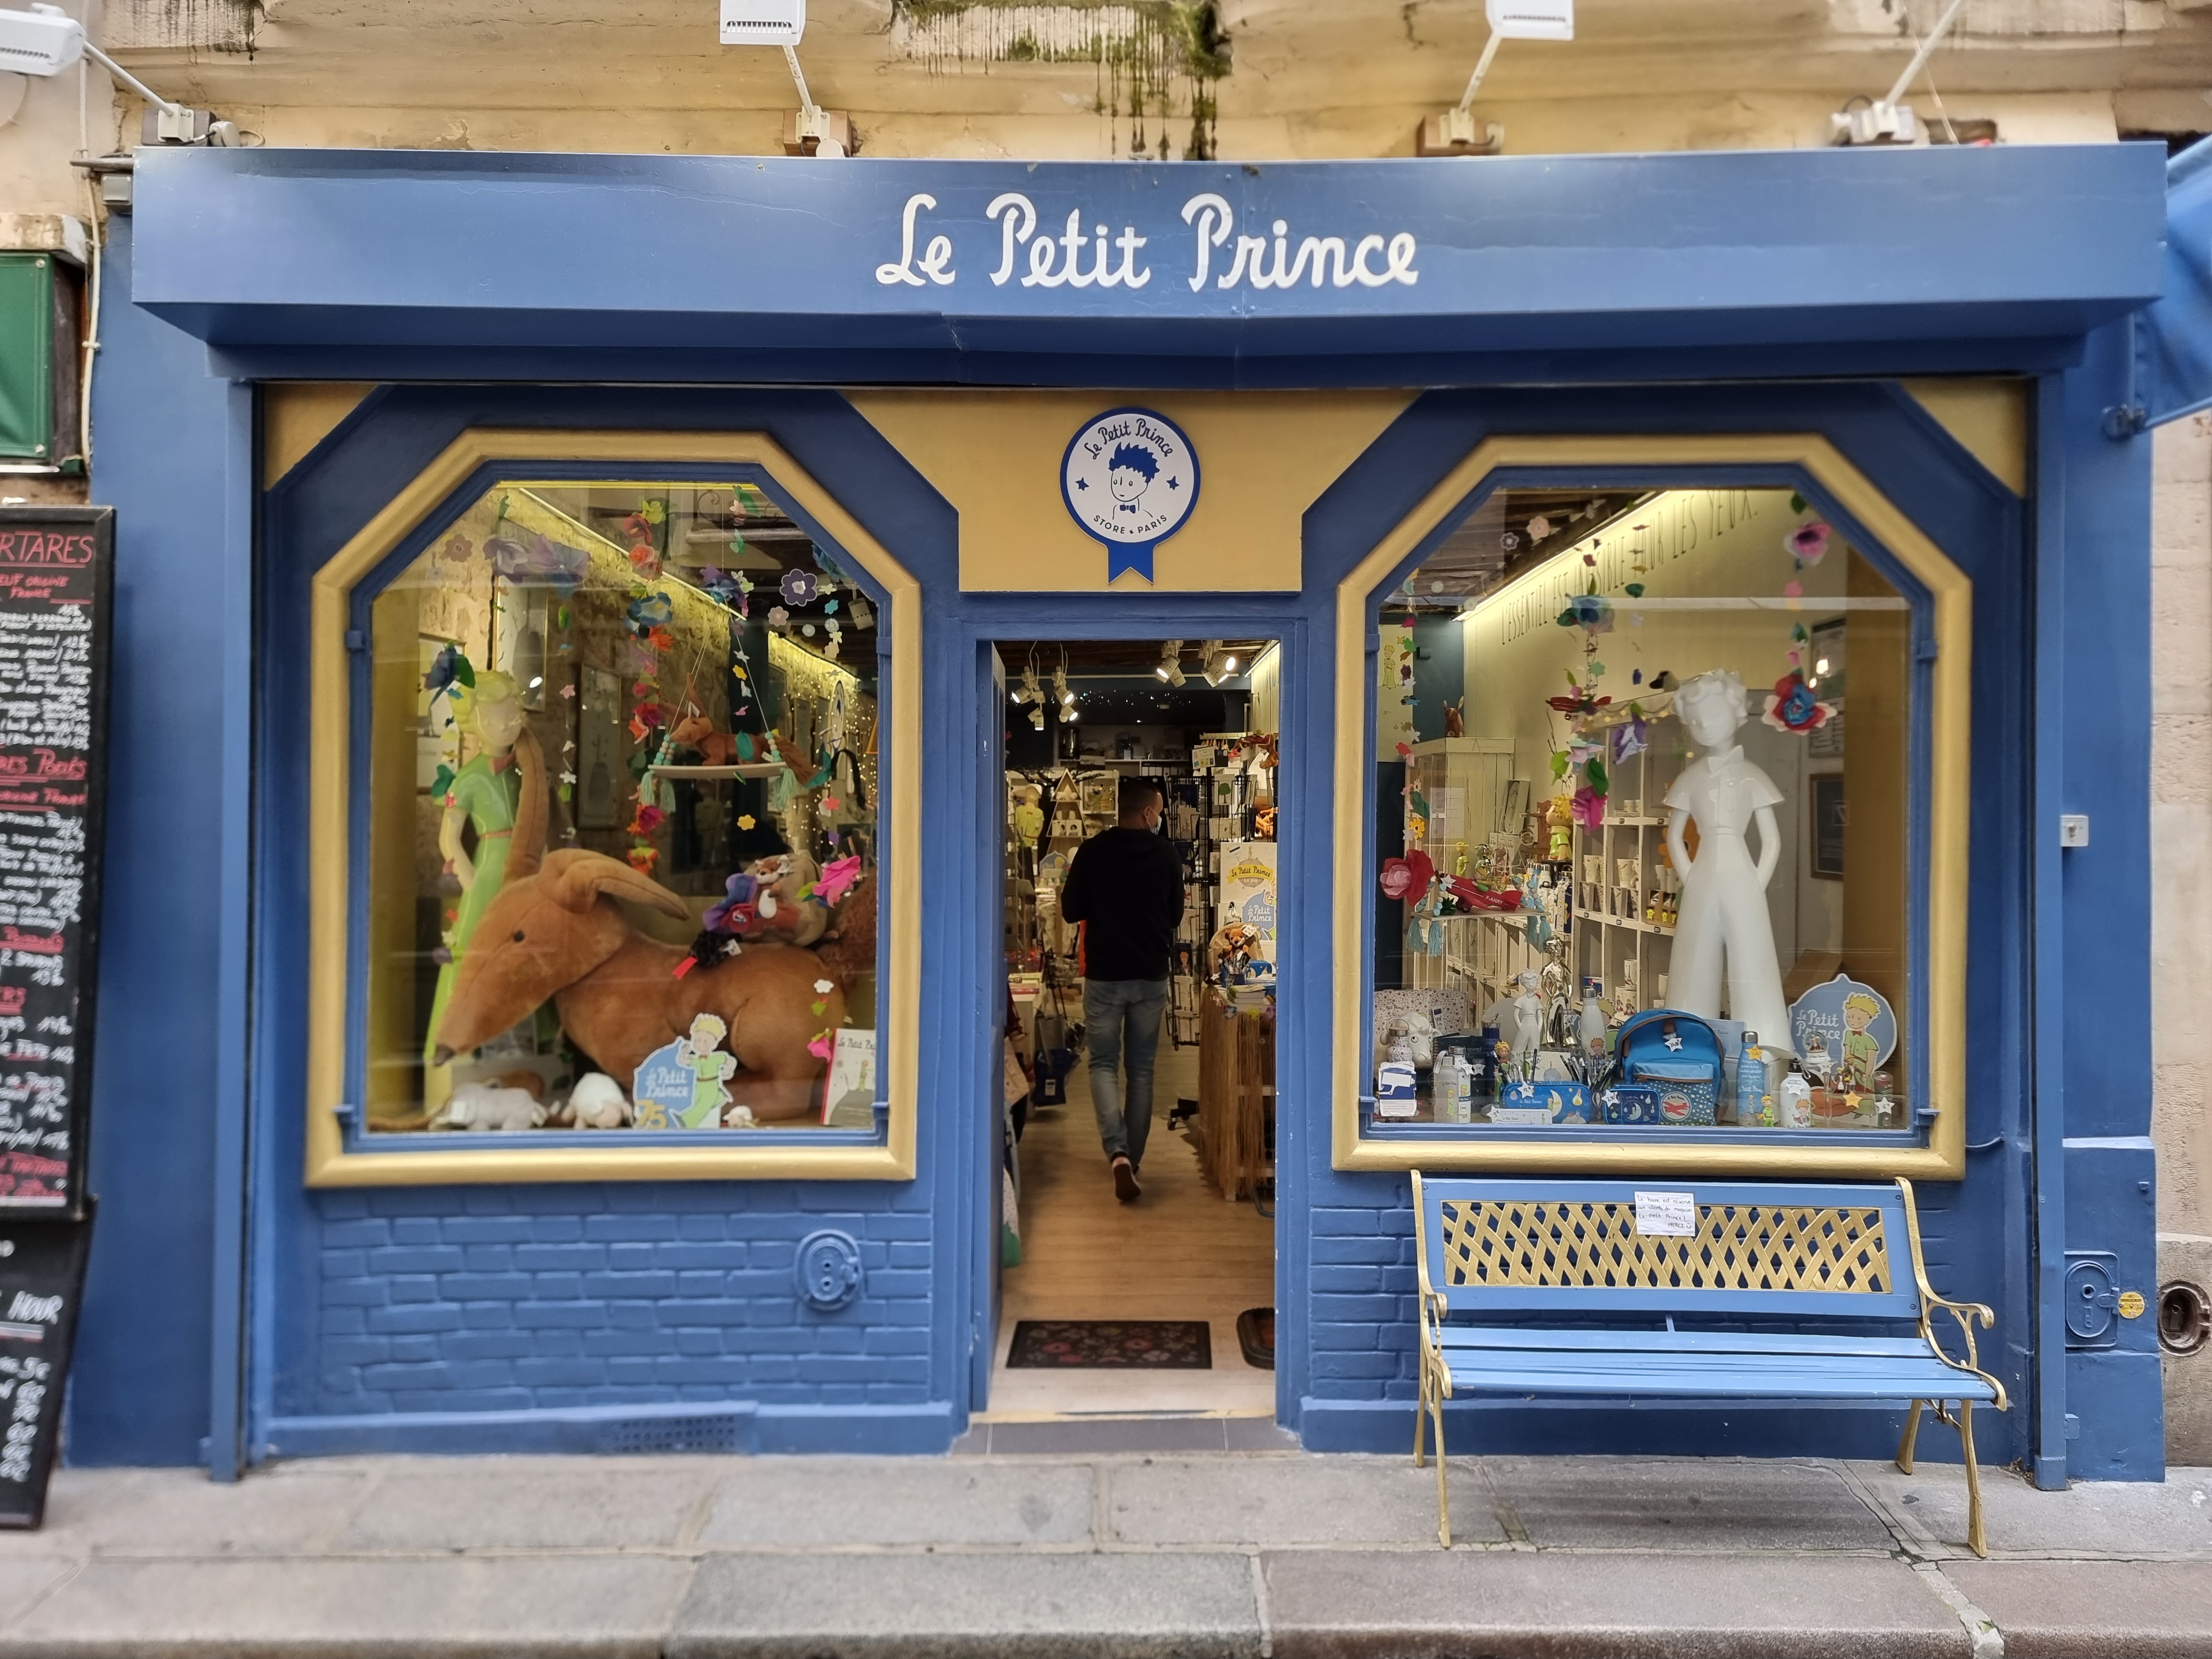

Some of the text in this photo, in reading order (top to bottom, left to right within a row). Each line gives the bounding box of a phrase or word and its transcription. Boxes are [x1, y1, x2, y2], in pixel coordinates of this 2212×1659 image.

[875, 193, 1419, 293] Le Petit Prince
[1084, 418, 1173, 460] Le Petit Prince
[1094, 515, 1167, 534] STORE PARIS
[1672, 494, 1697, 559] LES
[1238, 867, 1251, 875] Petit
[1253, 866, 1271, 877] Prince
[1248, 912, 1272, 922] Prince
[1254, 904, 1271, 915] Petit
[1796, 1009, 1839, 1027] Le Petit
[657, 1066, 687, 1084] Petit
[637, 1099, 667, 1129] 75
